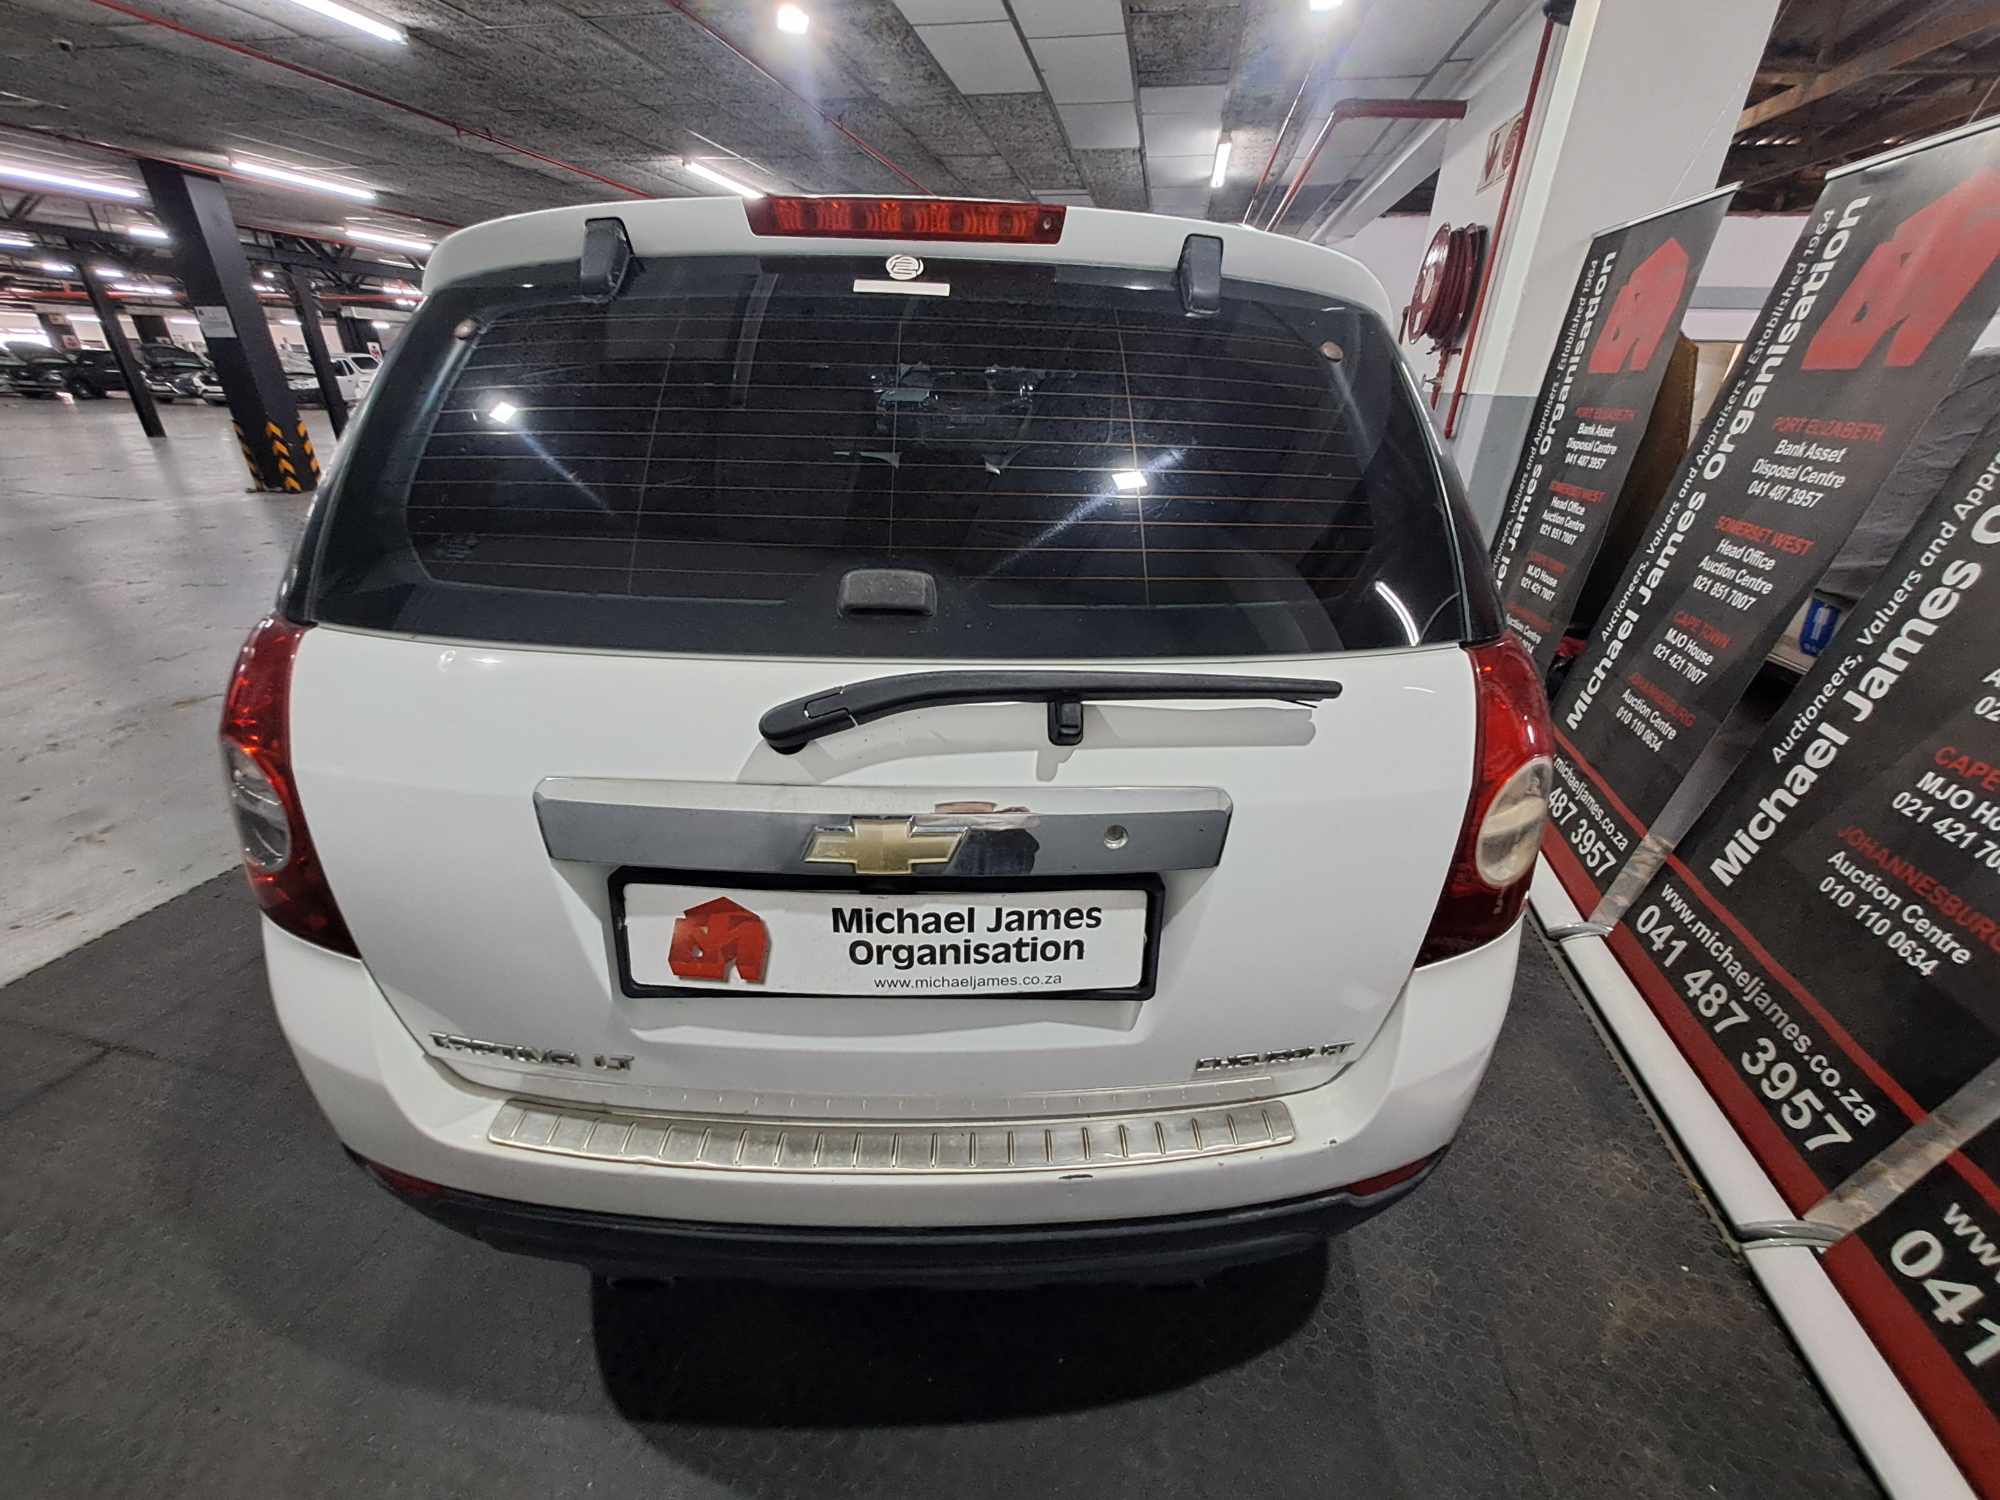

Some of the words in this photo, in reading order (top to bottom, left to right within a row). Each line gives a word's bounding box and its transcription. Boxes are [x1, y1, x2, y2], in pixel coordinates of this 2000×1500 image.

[1508, 463, 1543, 552] James
[1539, 251, 1617, 456] Organisation
[1510, 473, 1529, 513] Valuers
[1526, 446, 1538, 471] and
[1533, 382, 1560, 446] Appraisers
[1556, 297, 1587, 371] Established
[1582, 259, 1599, 293] 1964
[1577, 423, 1598, 437] Bank
[1595, 425, 1616, 437] Asset
[1602, 561, 1650, 642] Auctioneers,
[1646, 502, 1681, 555] Valuers
[1678, 467, 1698, 498] and
[1696, 379, 1747, 466] Appraisers
[1747, 262, 1808, 365] Established
[1803, 208, 1835, 257] 1964
[1805, 418, 1888, 440] ELIZABETH
[1566, 437, 1593, 453] Disposal
[1592, 441, 1617, 455] Centre
[1566, 609, 1640, 730] Michael
[1638, 491, 1707, 606] James
[1703, 195, 1872, 480] Organisation
[1774, 439, 1806, 457] Bank
[1804, 443, 1848, 463] Asset
[1751, 458, 1800, 479] Disposal
[1799, 465, 1847, 488] Centre
[1550, 497, 1567, 510] Head
[1567, 501, 1586, 516] Office
[1747, 480, 1767, 497] 041
[1767, 485, 1789, 501] 487
[1787, 490, 1825, 508] 3957
[1542, 510, 1564, 525] Auction
[1716, 538, 1745, 560] Head
[1743, 547, 1777, 571] Office
[1772, 533, 1816, 555] WEST
[1693, 575, 1711, 592] 021
[1709, 582, 1730, 601] 851
[1726, 590, 1757, 611] 7007
[1698, 555, 1738, 580] Auction
[1735, 569, 1774, 595] Centre
[1664, 627, 1689, 648] MJO
[1684, 641, 1714, 666] House
[1772, 654, 1864, 764] Auctioneers,
[1857, 569, 1922, 646] Valuers
[1920, 521, 1957, 567] and
[1652, 642, 1670, 660] 021
[1668, 653, 1686, 670] 421
[1682, 662, 1708, 685] 7007
[1616, 706, 1632, 724] 010
[1629, 716, 1645, 736] 110
[1622, 688, 1652, 715] Auction
[1648, 710, 1677, 740] Centre
[1710, 720, 1850, 887] Michael
[1842, 559, 1982, 722] James
[1916, 771, 1975, 810] MJO
[1549, 787, 1578, 826] 487
[1571, 818, 1617, 878] 3957
[1892, 792, 1934, 823] 021
[1932, 817, 1978, 849] 421
[832, 907, 975, 934] Michael
[986, 905, 1102, 934] James
[1819, 876, 1855, 909] 010
[1855, 904, 1890, 937] 110
[1887, 931, 1939, 977] 0634
[1828, 851, 1903, 911] Auction
[1902, 904, 1971, 965] Centre
[848, 935, 1085, 970] Organisation
[874, 972, 1063, 989] www.michaeljames.co.za
[1660, 883, 1877, 1128] www.michaeljames.co.za
[1635, 904, 1688, 968] 041
[1682, 968, 1750, 1034] 487
[1741, 1037, 1853, 1151] 3957
